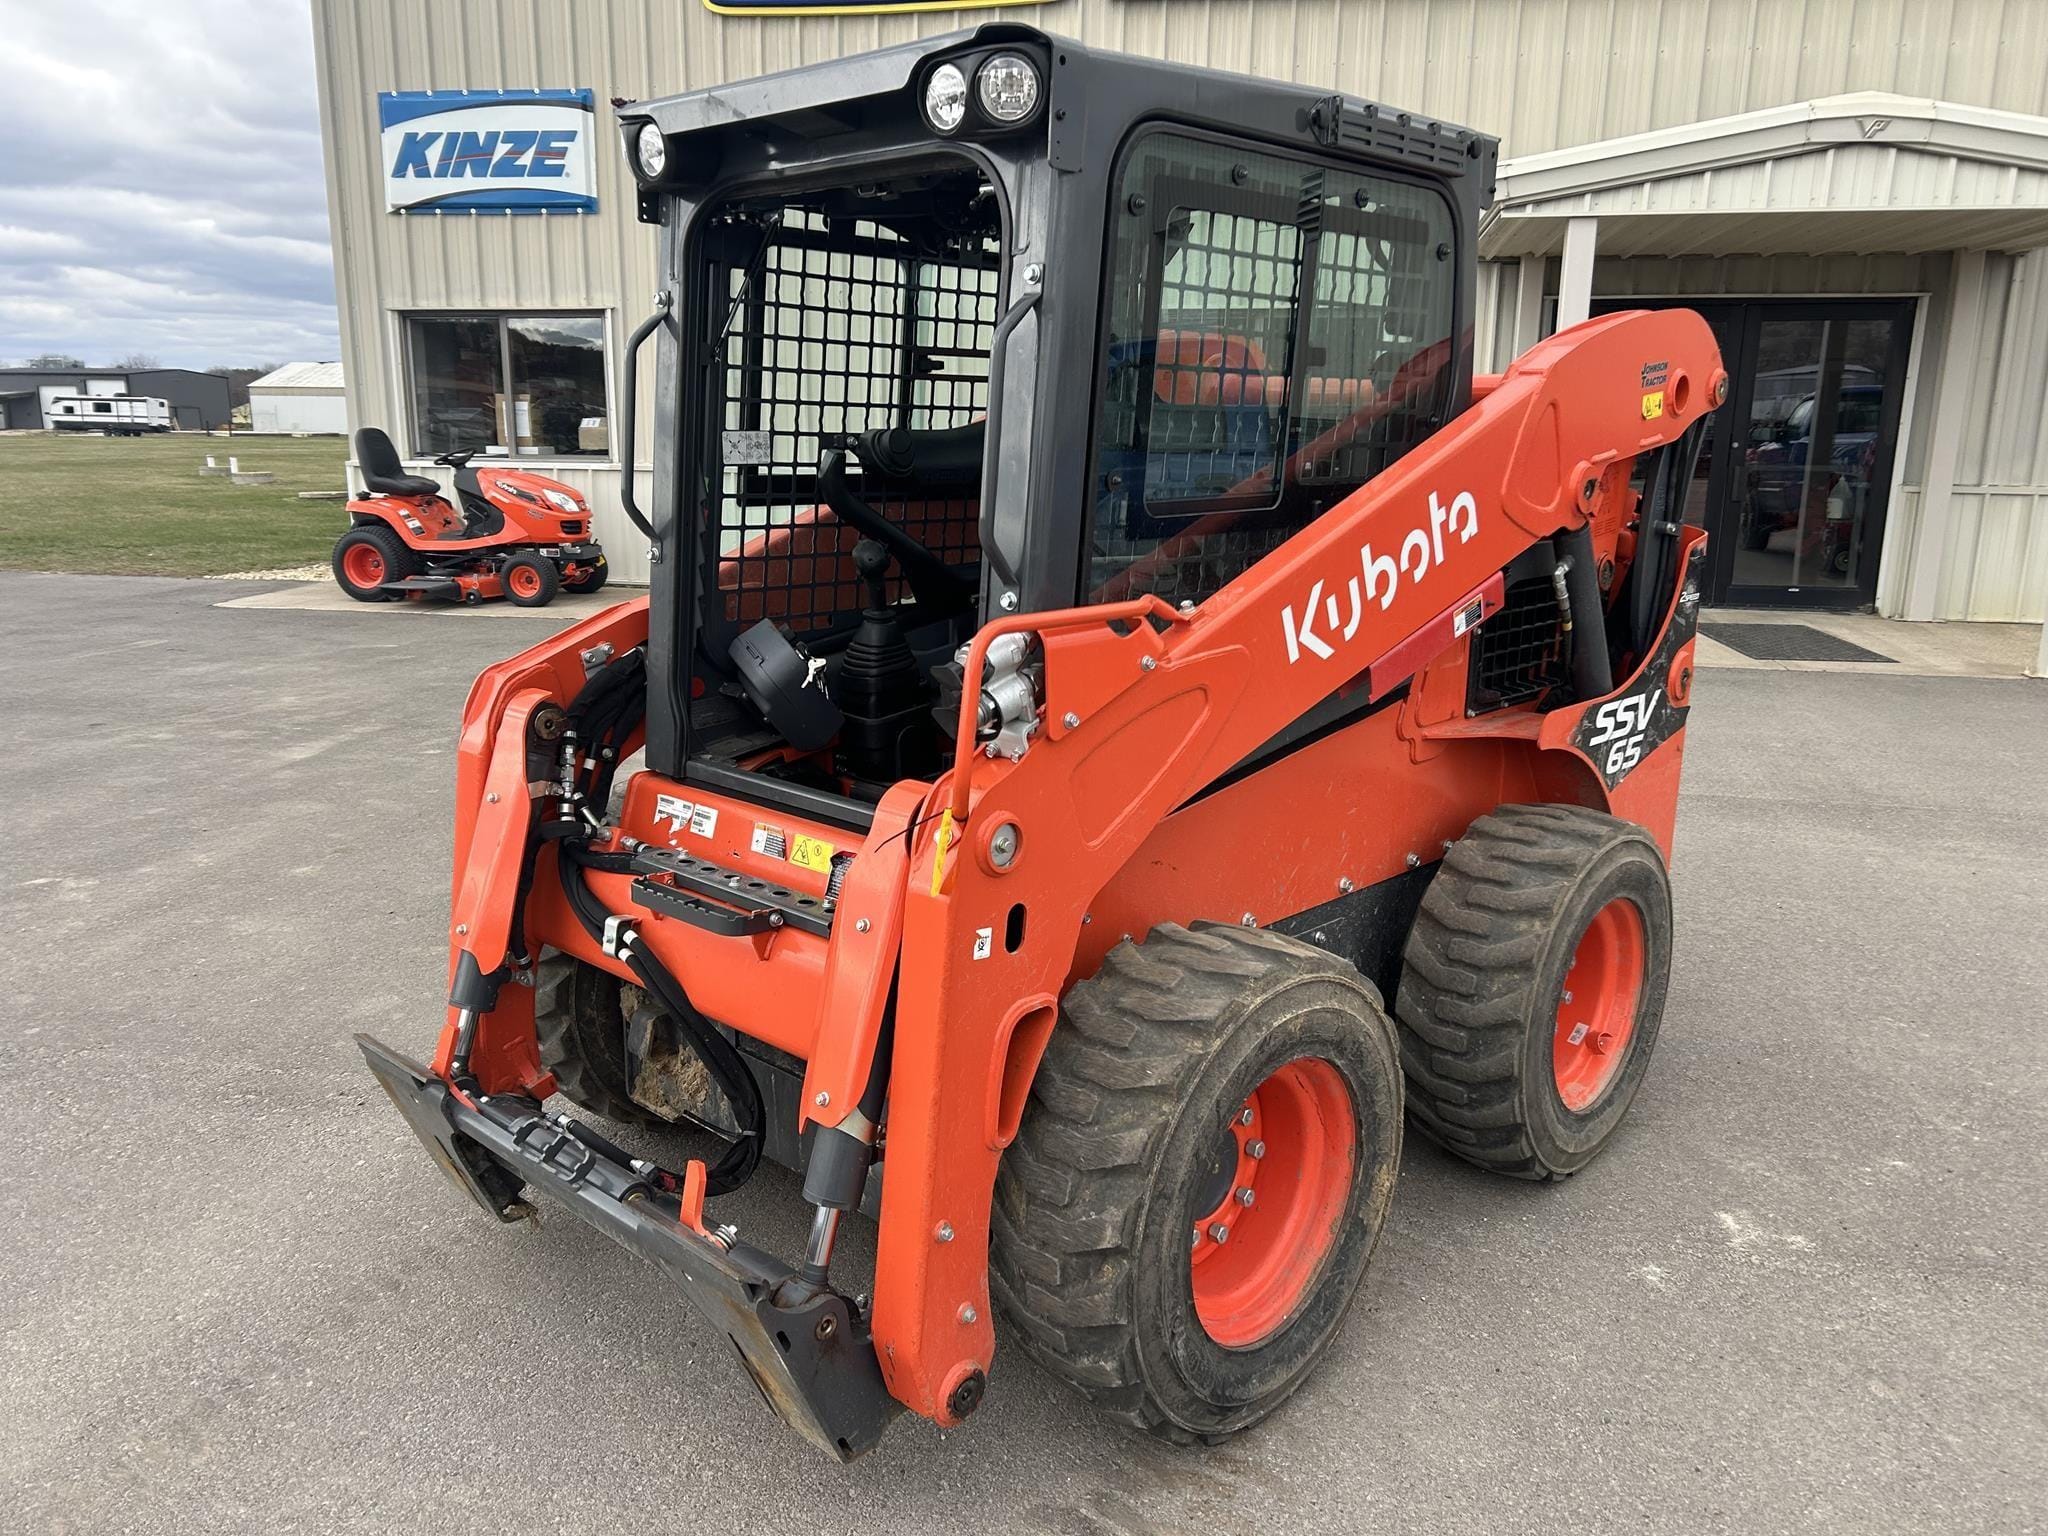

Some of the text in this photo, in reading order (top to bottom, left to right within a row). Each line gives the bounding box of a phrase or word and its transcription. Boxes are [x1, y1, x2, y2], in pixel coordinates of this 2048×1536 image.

[391, 130, 578, 178] KINZE
[1641, 375, 1667, 388] TRACTOR
[1281, 490, 1479, 665] Kubota
[1589, 688, 1662, 747] SSV
[1606, 733, 1645, 775] 65
